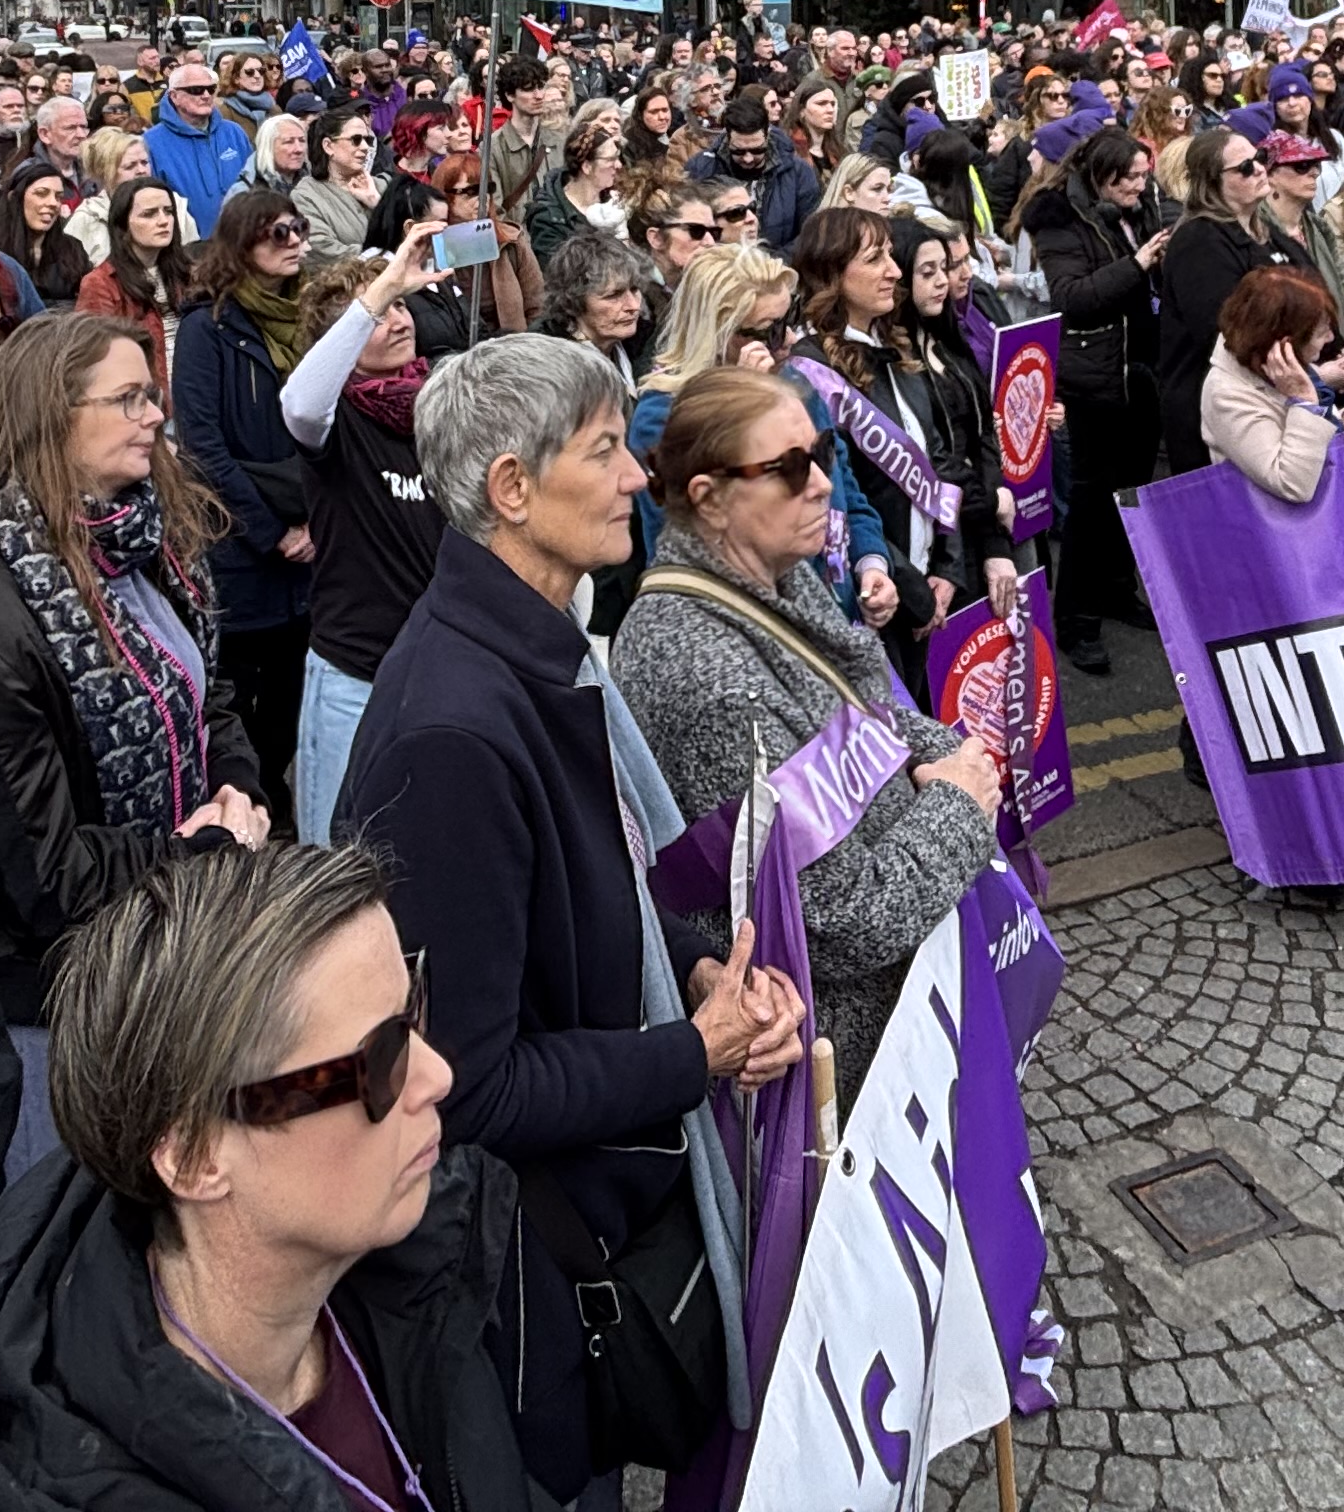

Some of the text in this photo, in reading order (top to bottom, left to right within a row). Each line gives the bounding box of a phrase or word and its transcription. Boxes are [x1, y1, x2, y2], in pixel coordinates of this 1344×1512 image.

[837, 385, 956, 524] Women's
[952, 640, 978, 676] YOU
[1006, 592, 1032, 825] Women's Aid
[1033, 674, 1052, 739] ONSHIP
